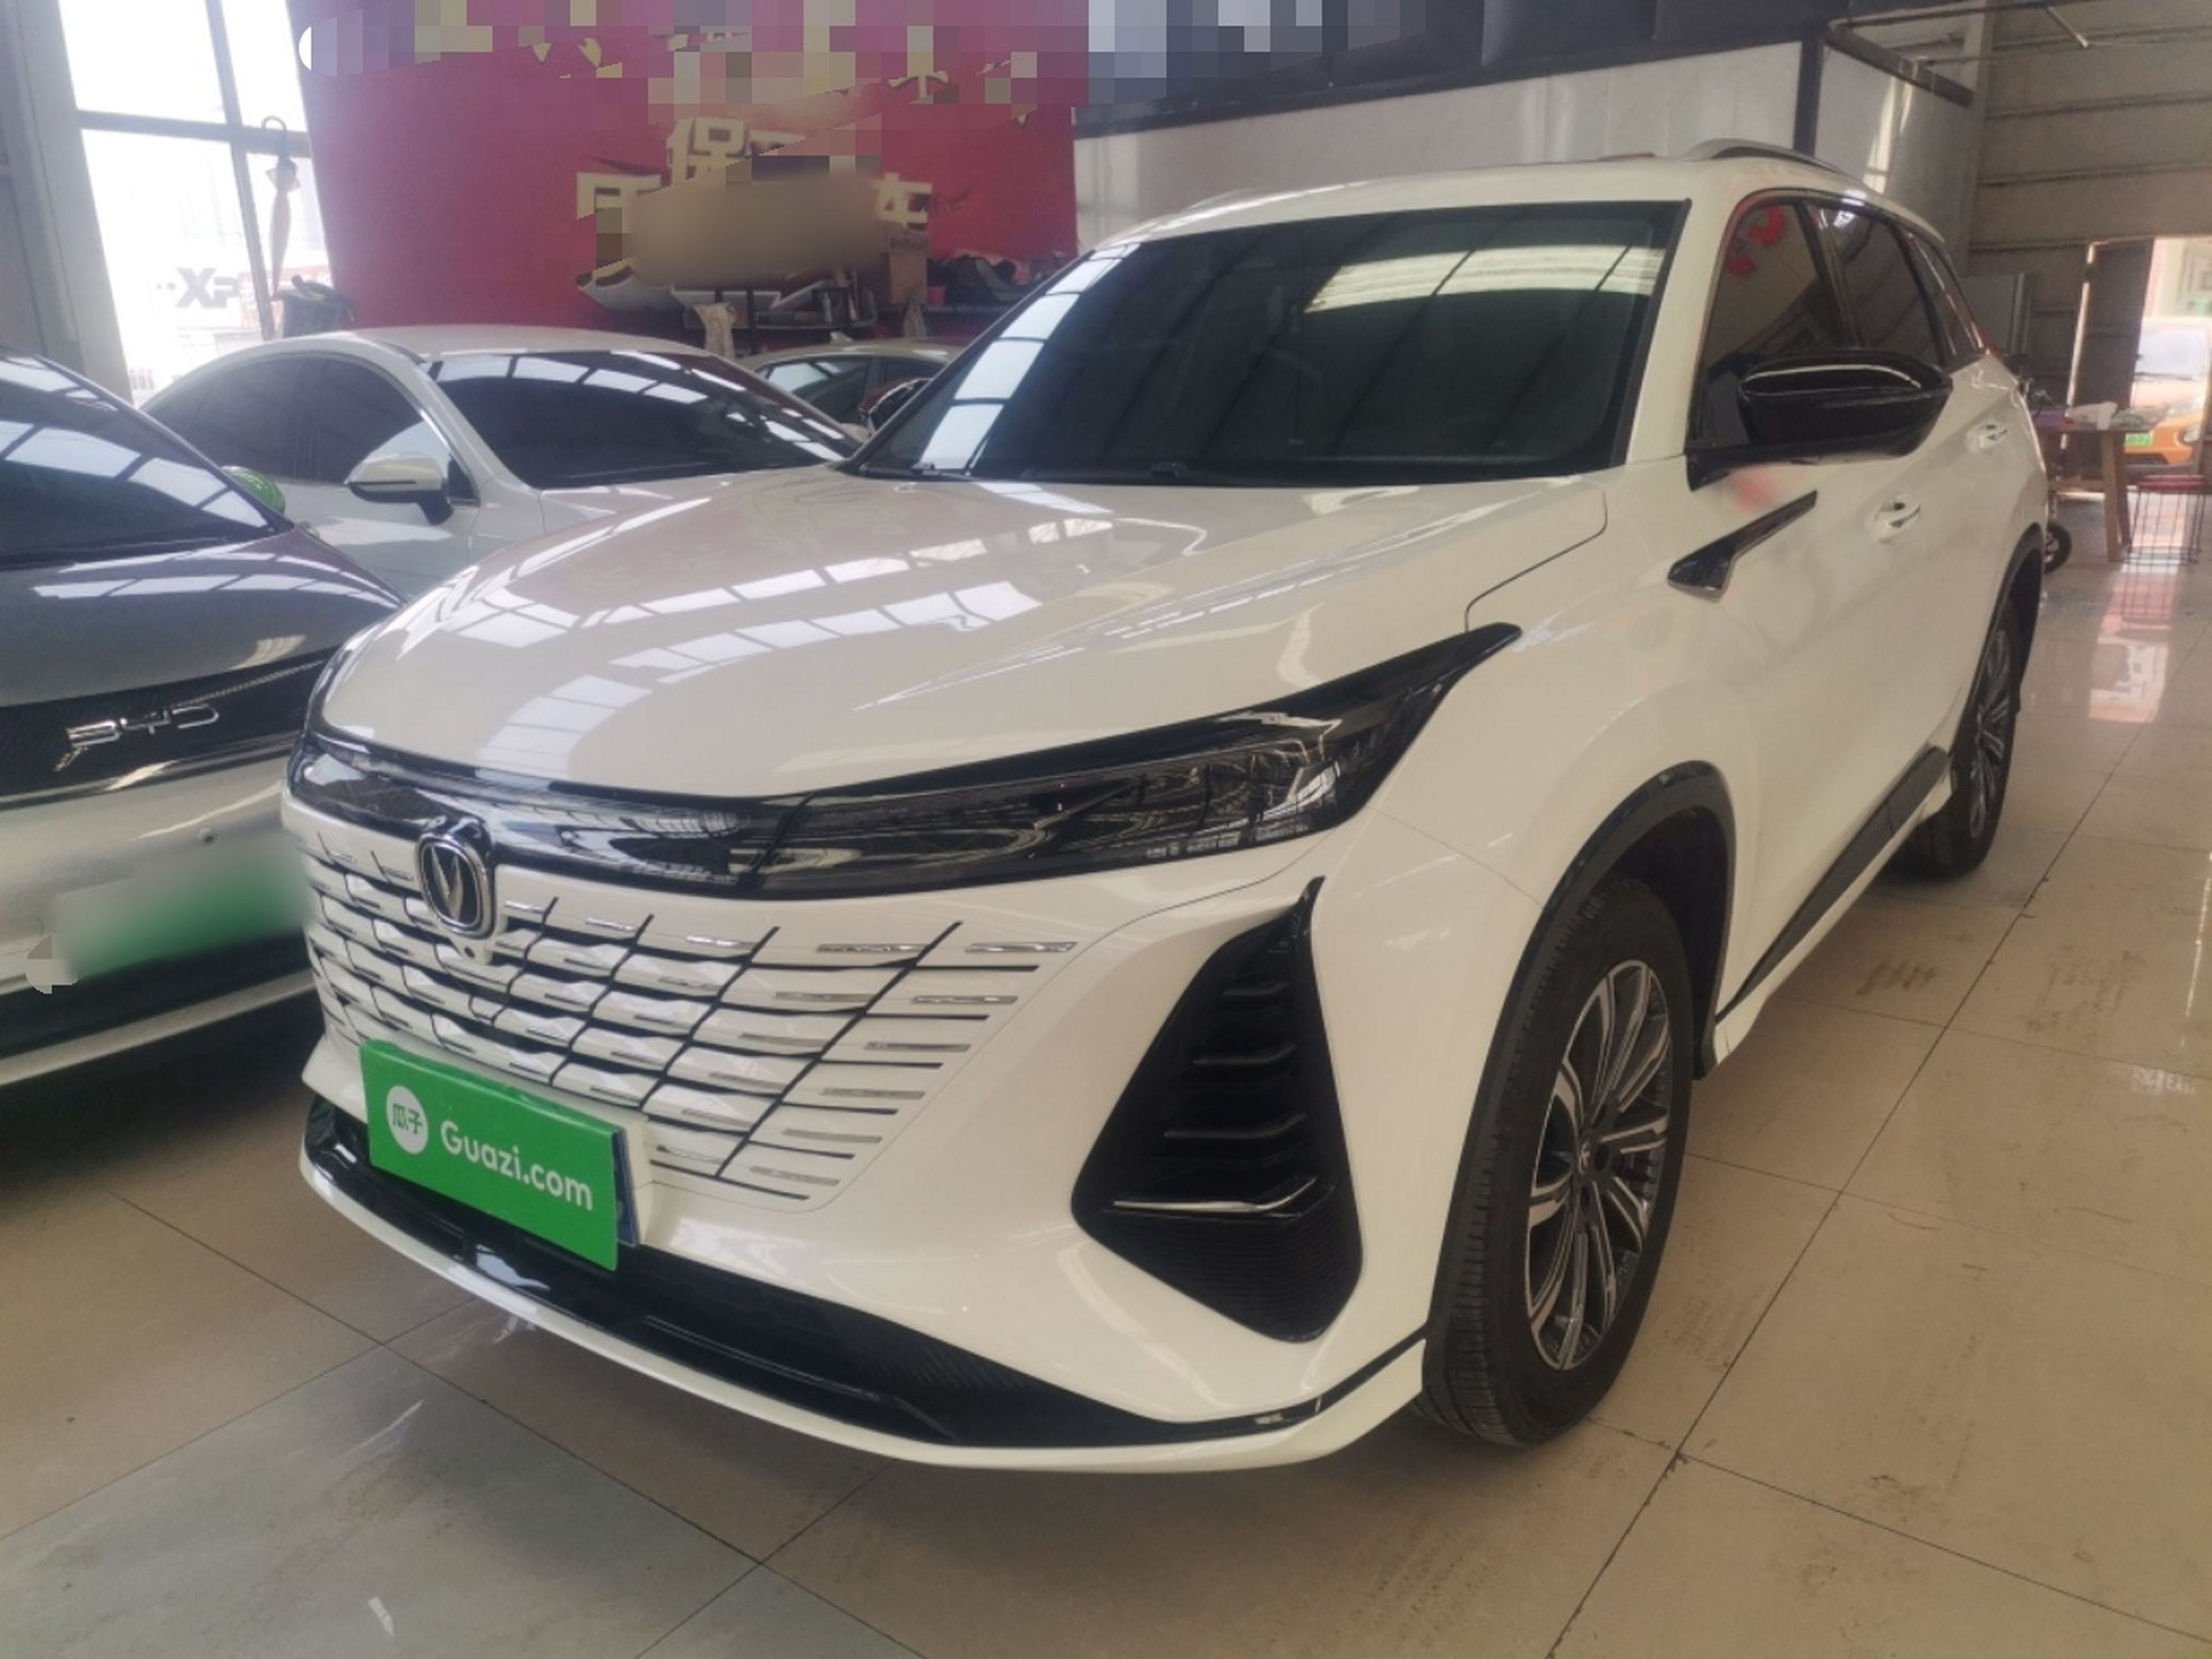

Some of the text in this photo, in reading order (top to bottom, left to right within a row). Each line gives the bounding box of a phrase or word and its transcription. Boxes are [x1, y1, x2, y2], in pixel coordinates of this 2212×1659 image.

[66, 703, 219, 748] BYD
[392, 1103, 593, 1211] 瓜子 Guazi.com
